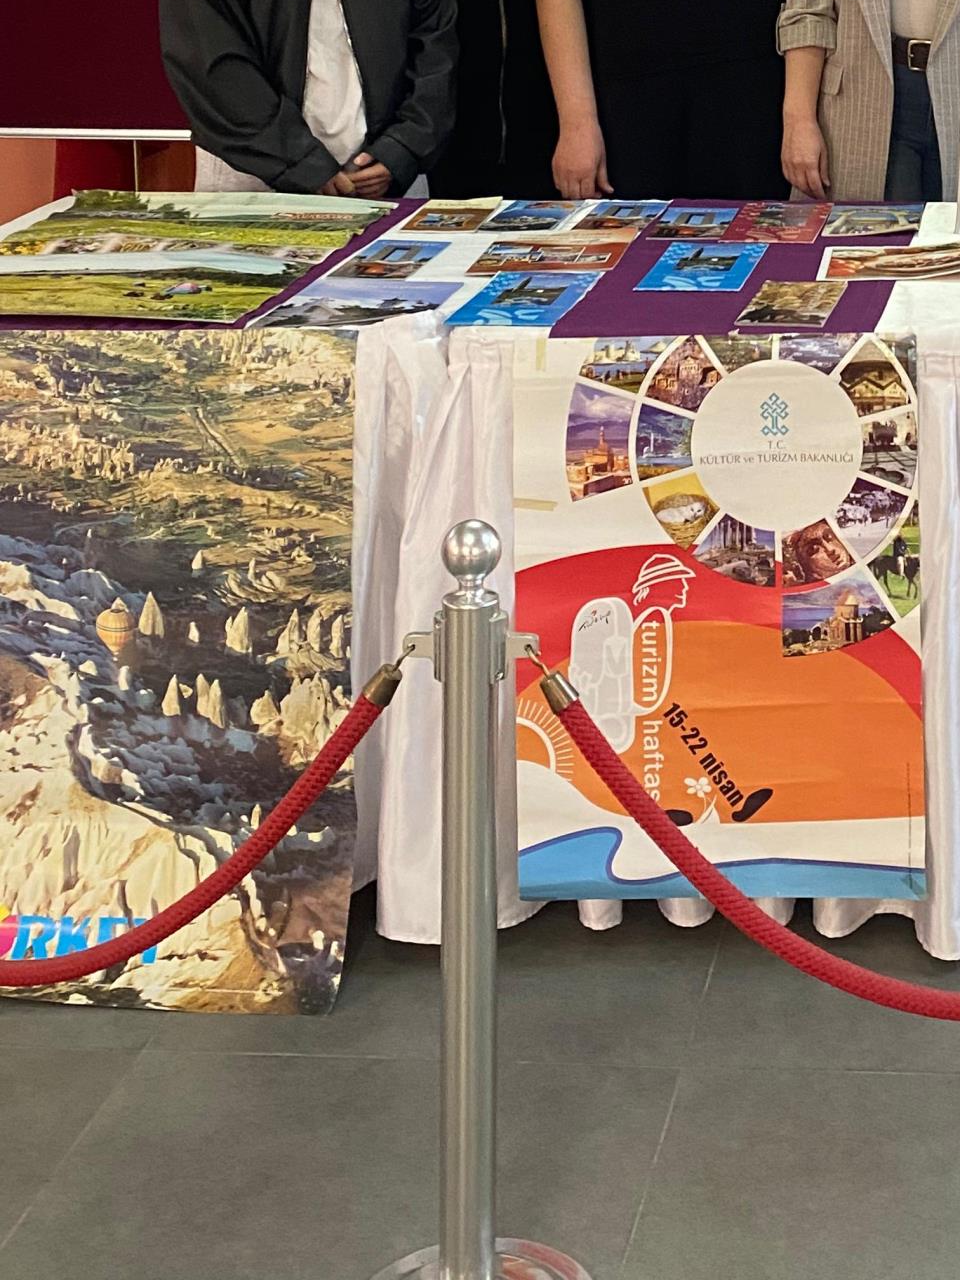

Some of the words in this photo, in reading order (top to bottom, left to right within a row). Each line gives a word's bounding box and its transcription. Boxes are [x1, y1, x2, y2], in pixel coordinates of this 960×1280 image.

[700, 452, 741, 465] KÜLTÜR
[743, 456, 755, 464] ve
[757, 452, 798, 463] TURİZM
[800, 451, 854, 463] BAKANLIĞI
[640, 620, 661, 702] turizm
[643, 720, 665, 801] haftas
[662, 702, 709, 756] 15-22
[699, 752, 744, 808] nisan
